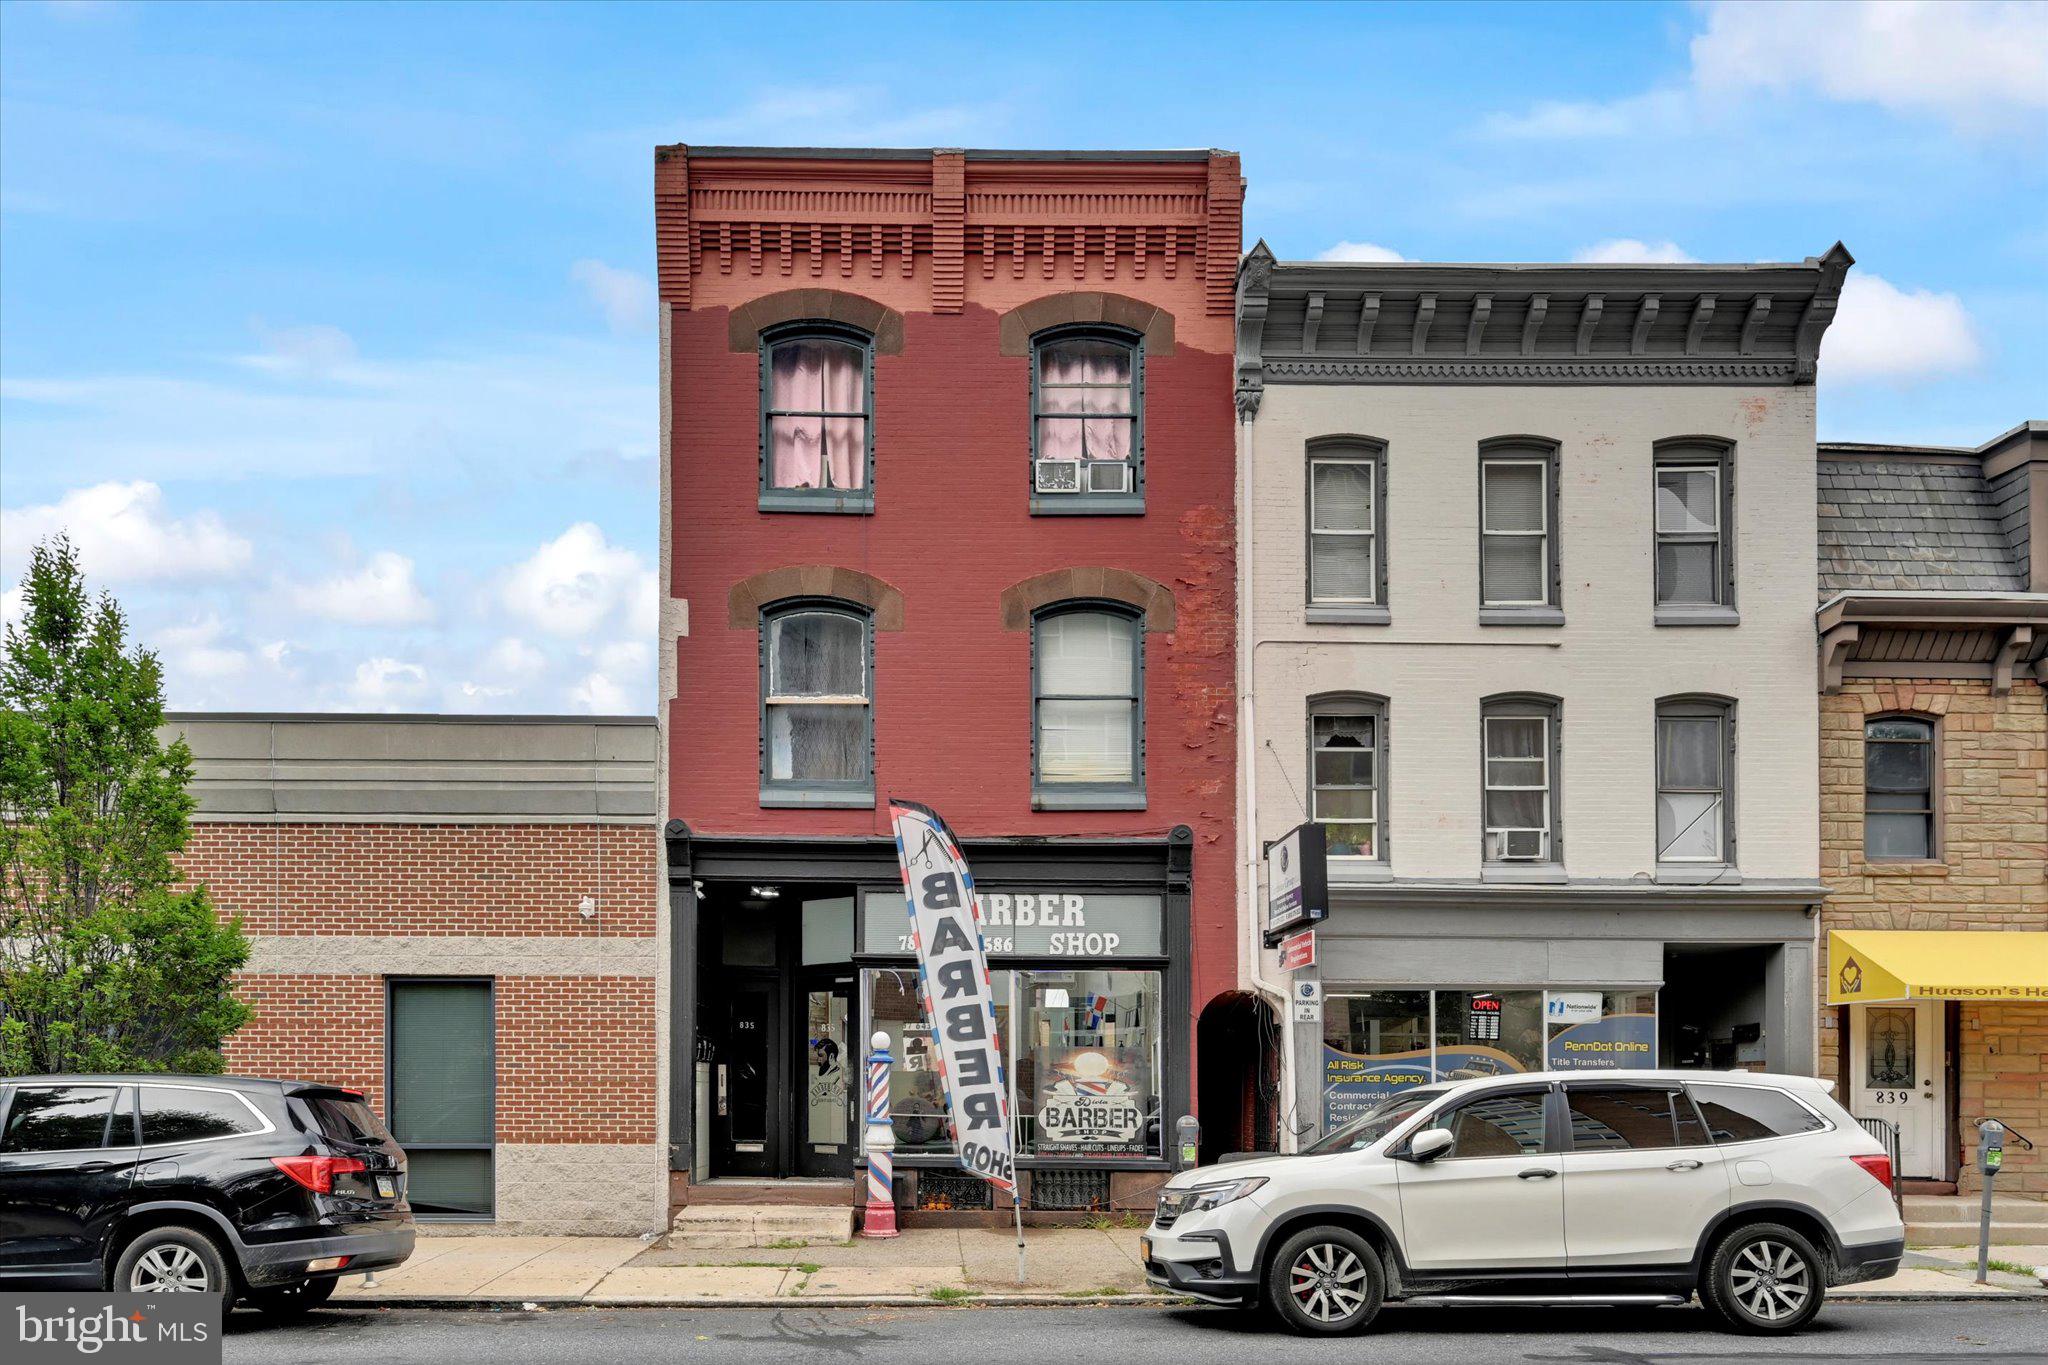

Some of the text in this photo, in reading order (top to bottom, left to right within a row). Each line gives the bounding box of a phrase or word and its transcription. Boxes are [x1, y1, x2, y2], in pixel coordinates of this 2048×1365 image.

[976, 894, 1085, 926] RBER
[1049, 933, 1120, 956] SHOP
[1472, 1000, 1499, 1010] OPEN
[739, 1021, 755, 1029] 835
[1564, 1042, 1649, 1052] PennDot Online
[1327, 1061, 1364, 1070] All Risk
[1552, 1058, 1615, 1066] Title Transfers
[1327, 1074, 1381, 1083] Insurance
[1329, 1091, 1390, 1100] Commercial
[1876, 1091, 1908, 1104] 839
[1045, 1107, 1138, 1129] BARBER
[1129, 1144, 1144, 1152] FADES
